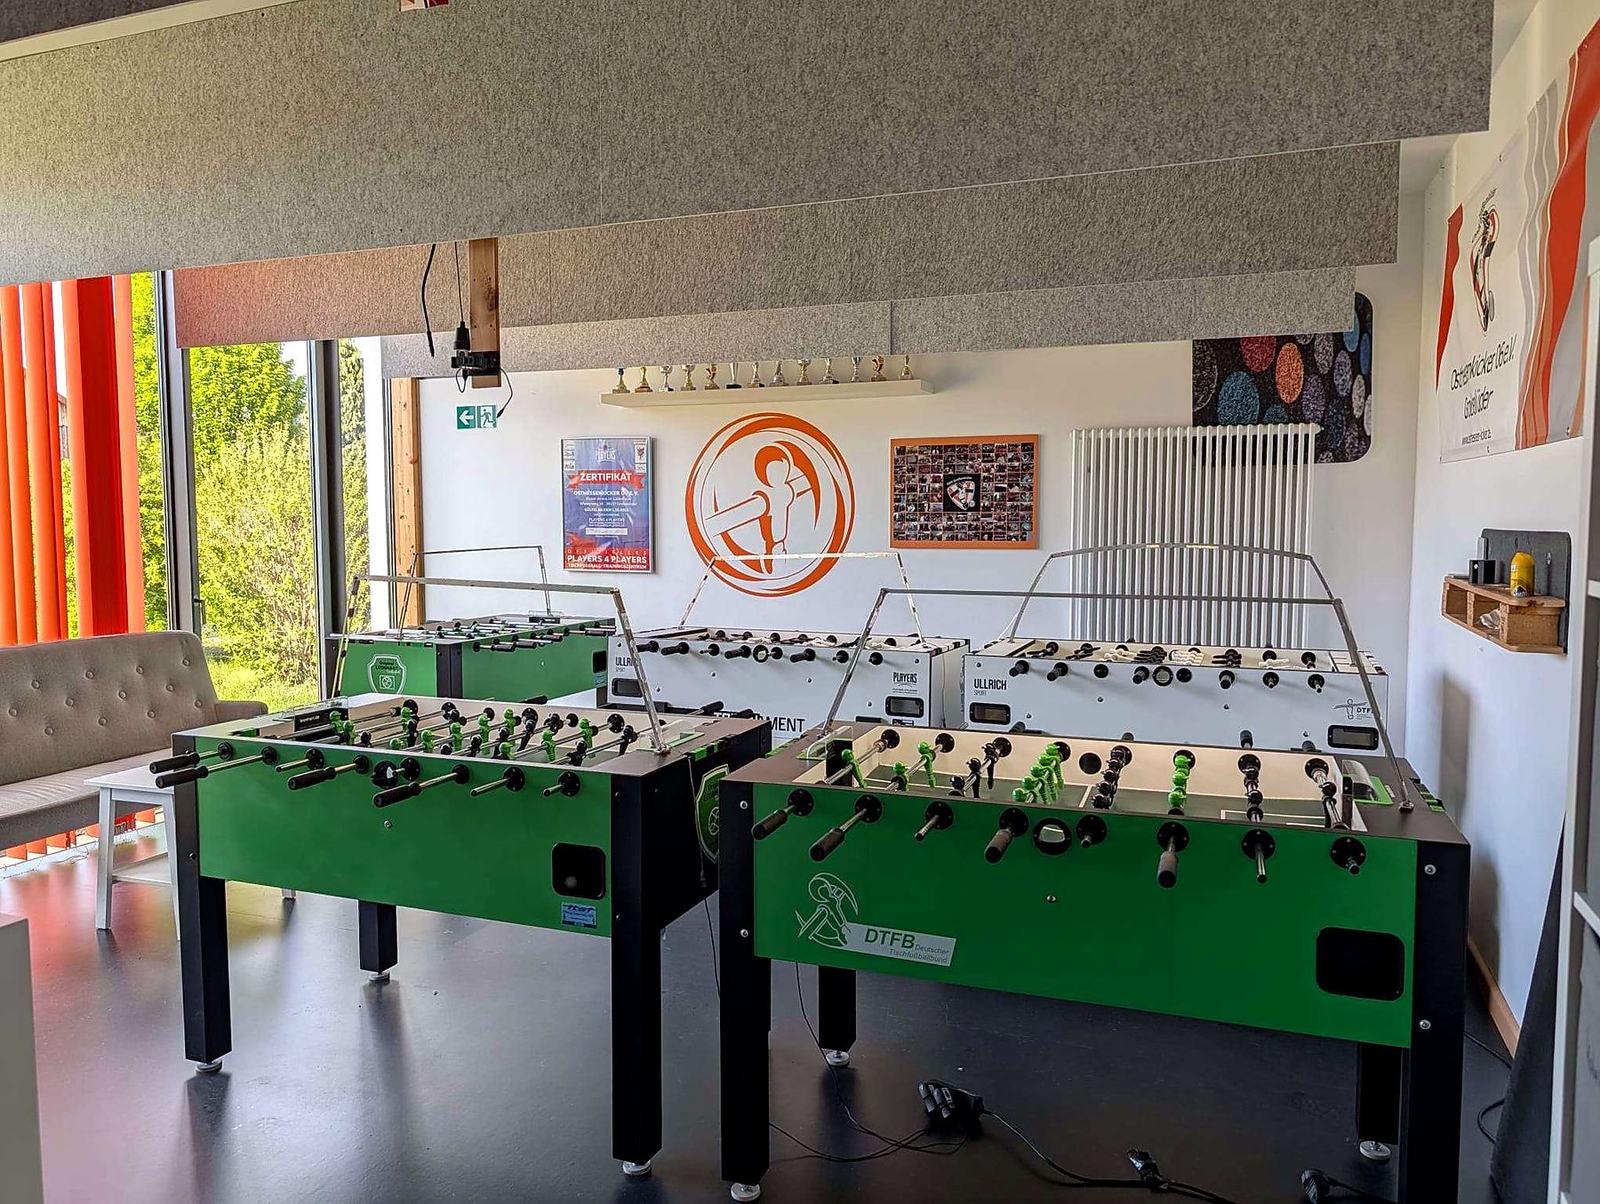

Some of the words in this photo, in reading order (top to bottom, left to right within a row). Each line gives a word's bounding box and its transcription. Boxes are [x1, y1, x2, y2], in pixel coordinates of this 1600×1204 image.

[580, 472, 633, 481] ZERTIFIKAT
[567, 555, 603, 563] PLAYERS
[604, 555, 610, 563] 4
[611, 555, 647, 564] PLAYERS
[892, 671, 918, 683] PLAYERS
[973, 678, 1007, 690] ULLRICH
[864, 928, 916, 949] DTFB
